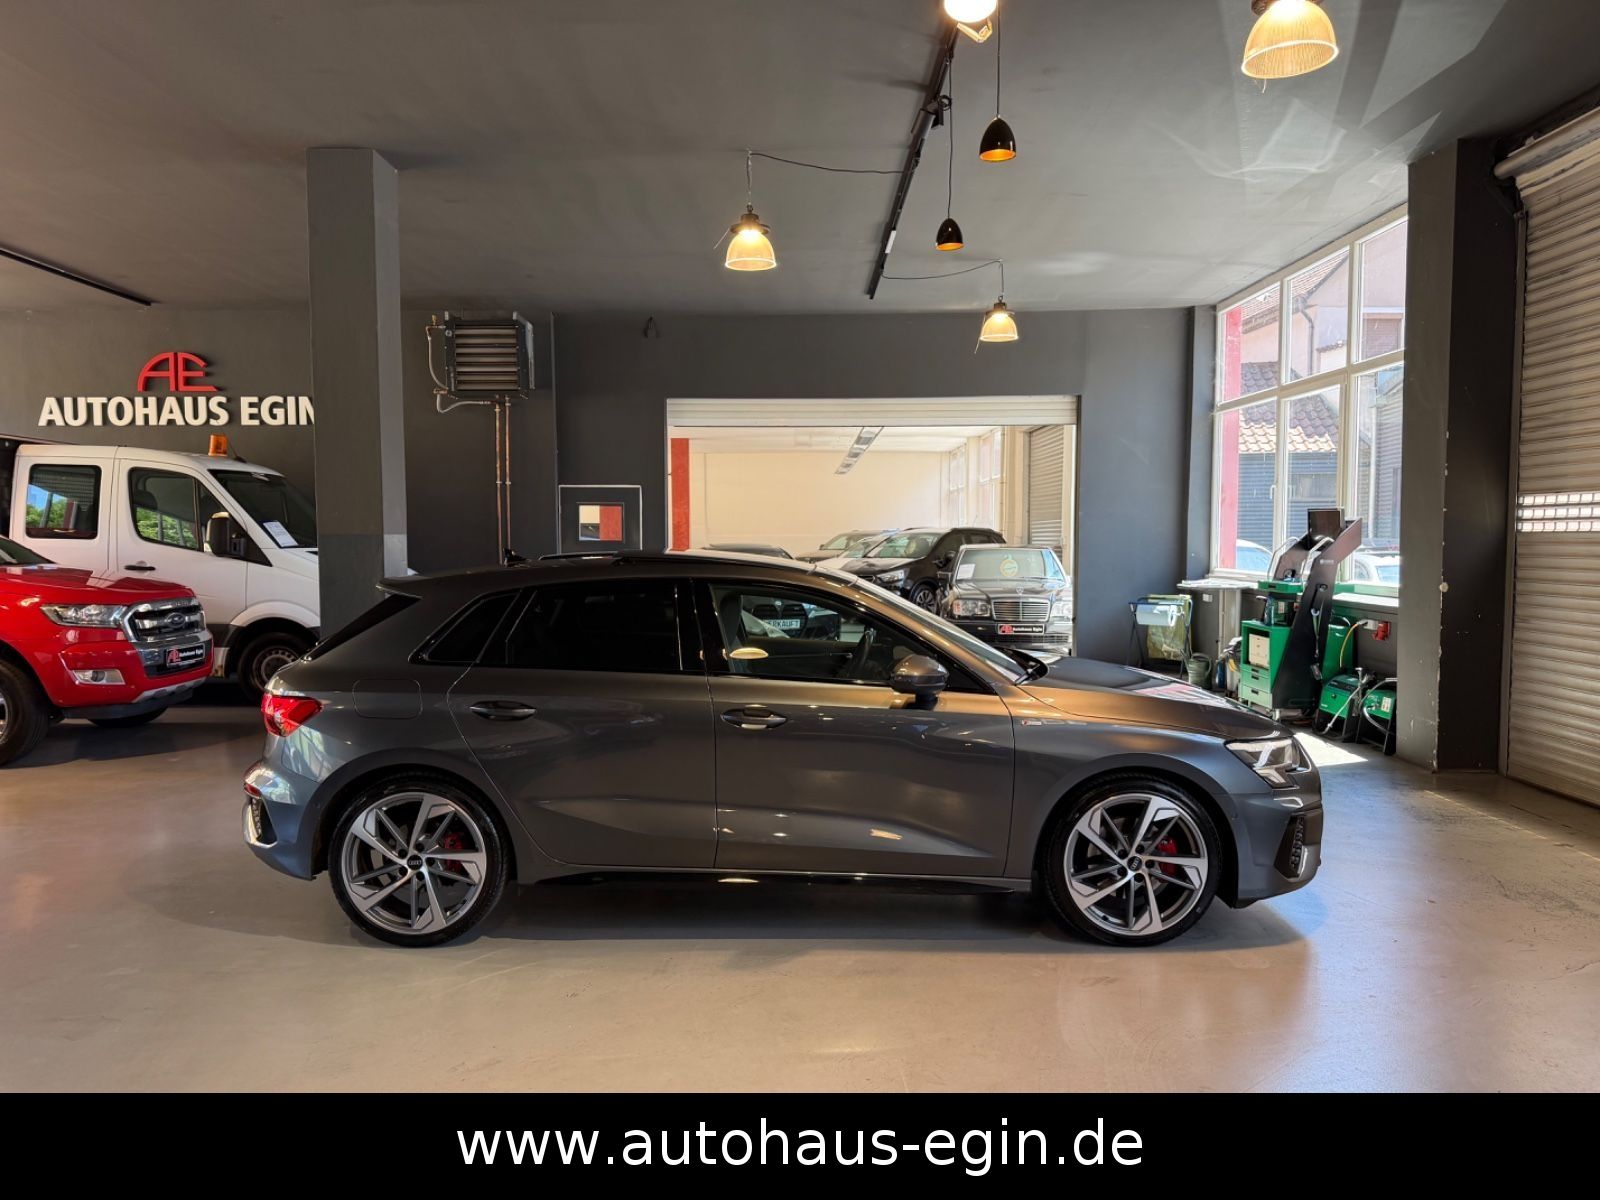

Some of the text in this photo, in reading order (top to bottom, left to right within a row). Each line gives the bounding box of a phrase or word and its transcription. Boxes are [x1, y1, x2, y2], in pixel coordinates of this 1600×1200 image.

[137, 351, 218, 392] AE
[38, 396, 315, 427] AUTOHAUS EGIN
